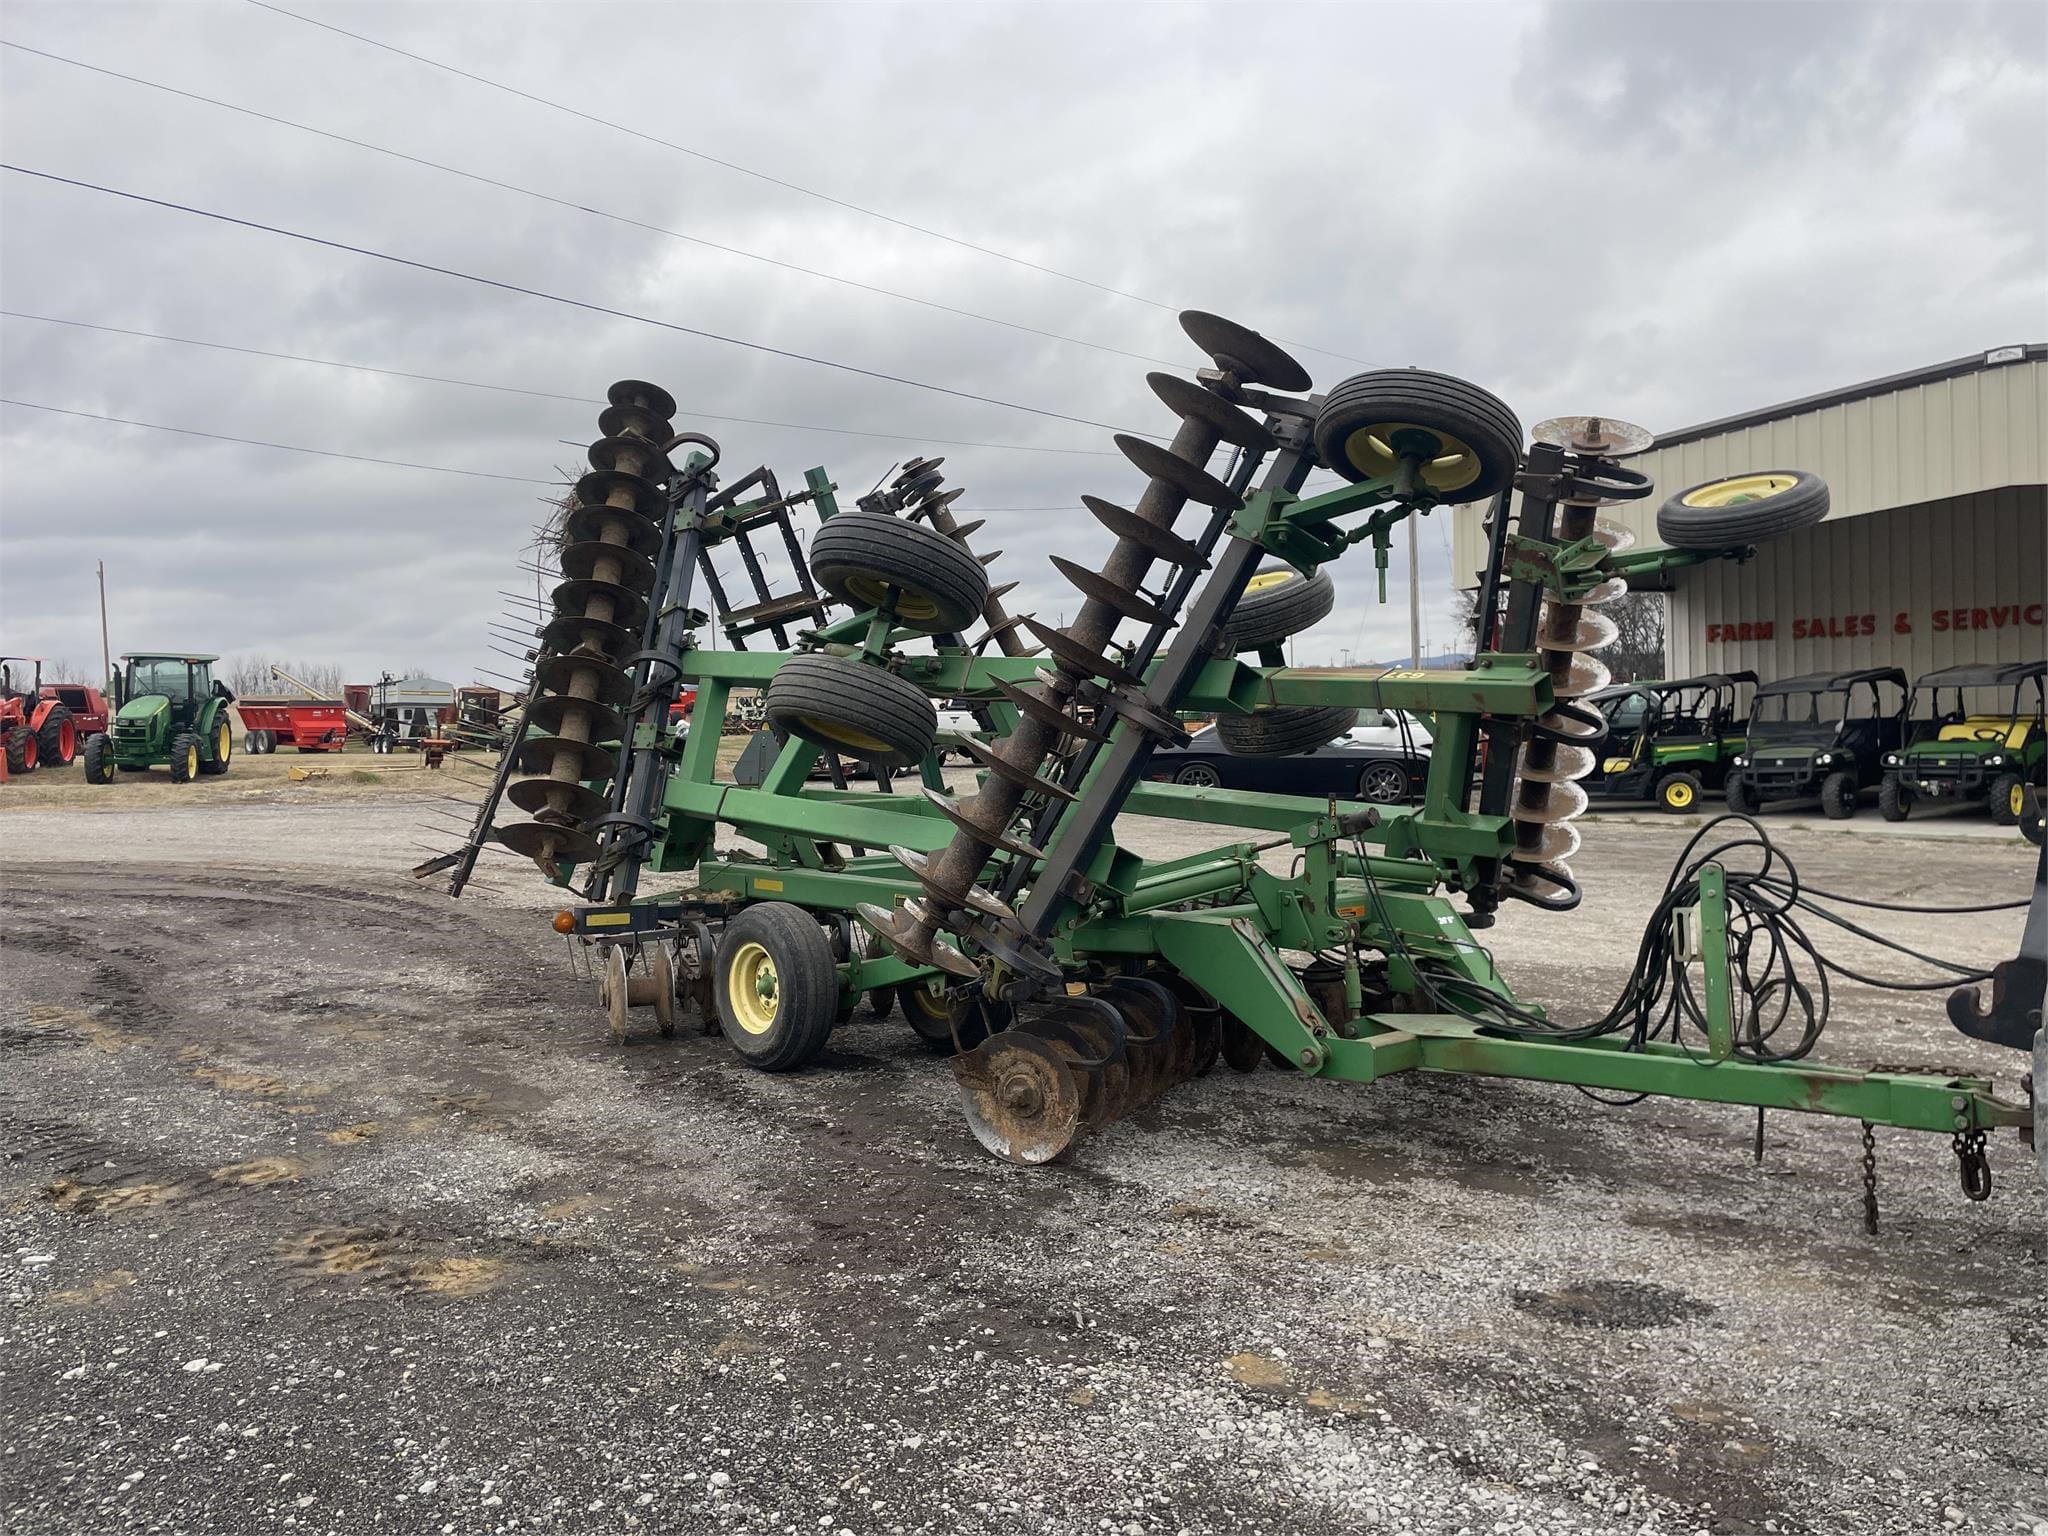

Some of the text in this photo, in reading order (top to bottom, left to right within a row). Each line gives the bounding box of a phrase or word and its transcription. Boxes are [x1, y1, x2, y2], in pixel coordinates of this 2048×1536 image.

[1706, 622, 1774, 643] FARM
[1792, 614, 1876, 640] SALES
[1894, 612, 1912, 635] &
